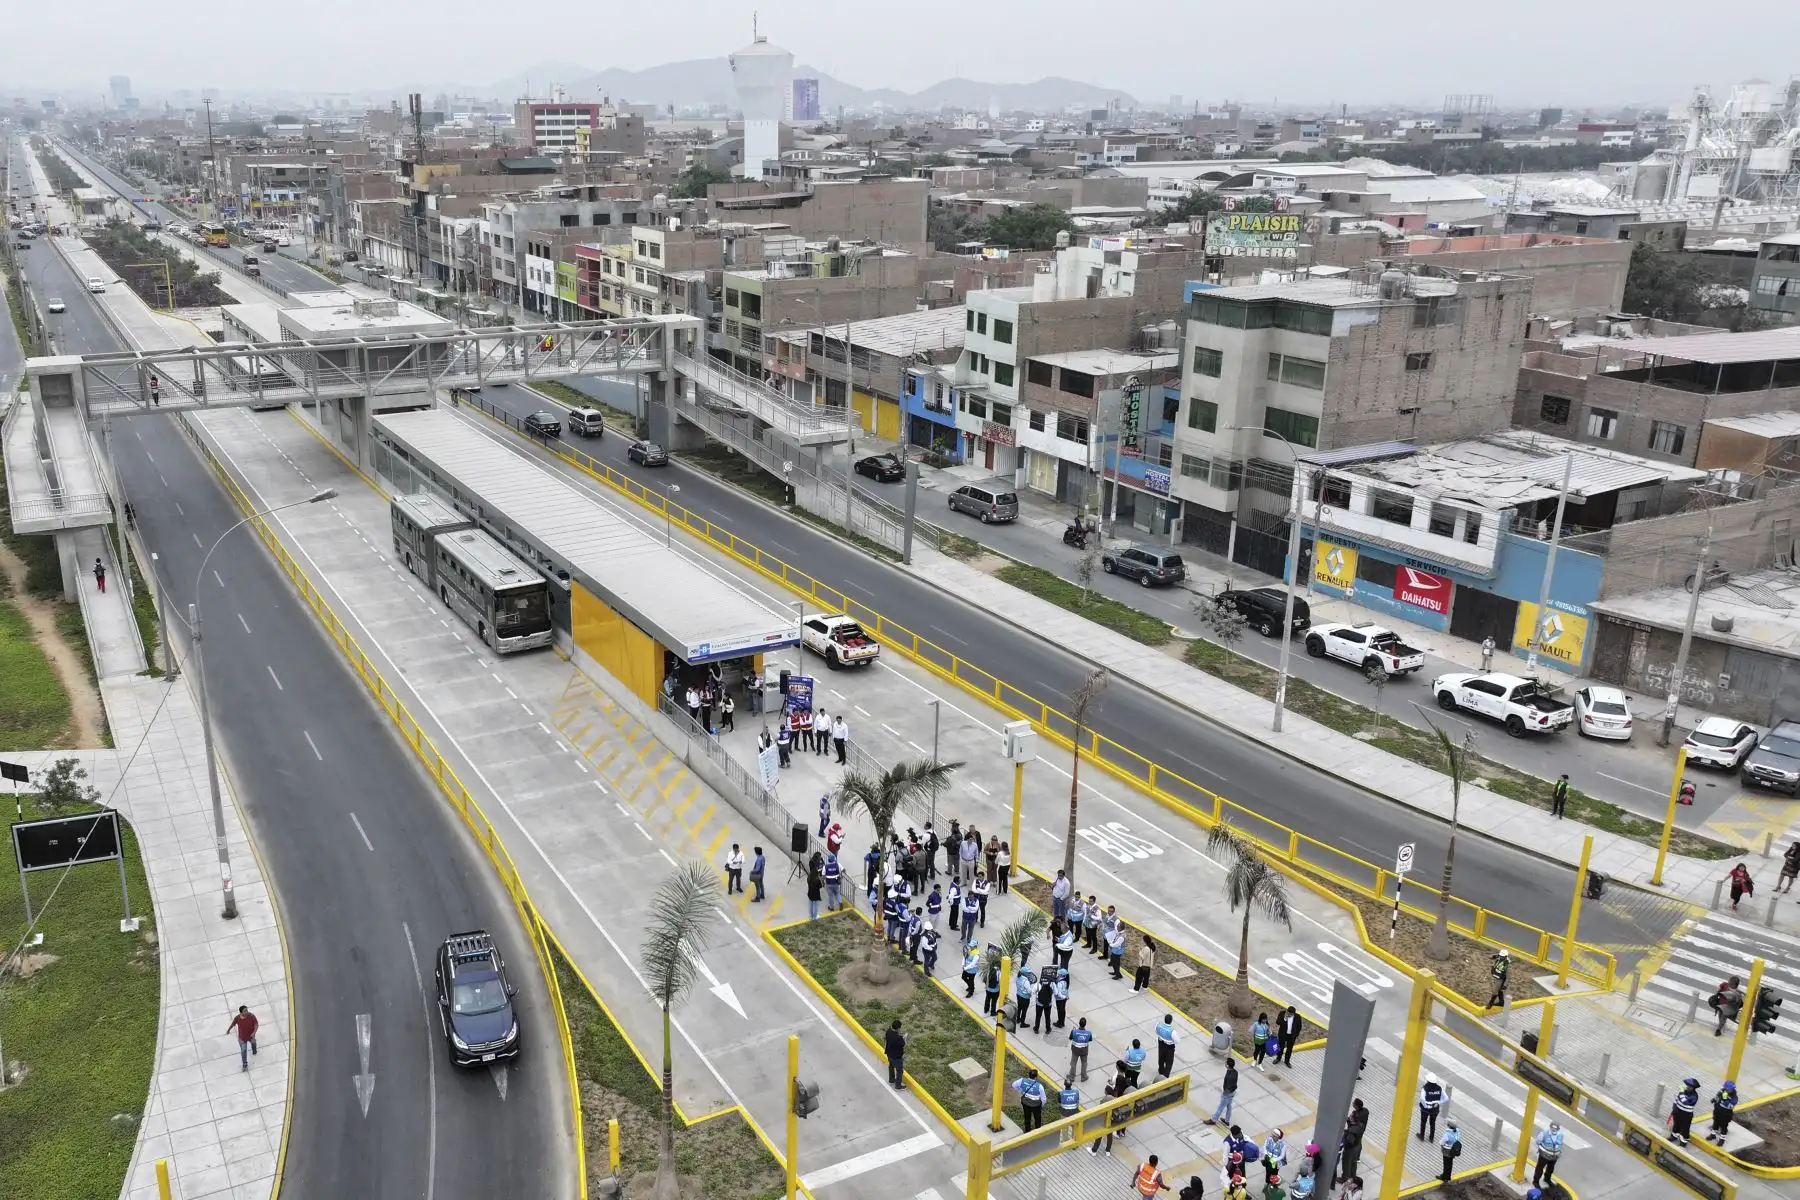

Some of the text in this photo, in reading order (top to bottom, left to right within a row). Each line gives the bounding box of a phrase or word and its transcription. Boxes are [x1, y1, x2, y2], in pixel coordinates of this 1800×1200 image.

[1224, 197, 1235, 210] 15
[1277, 198, 1288, 211] 20
[1190, 219, 1202, 234] 10
[1229, 215, 1300, 232] PLAISIR
[1306, 219, 1321, 234] 25
[1205, 245, 1297, 258] COCHERA
[1128, 392, 1140, 445] HOSTAL
[1145, 470, 1170, 482] HOSTAL
[1406, 557, 1448, 575] SERVICIO
[1317, 572, 1352, 588] RENAULT
[1401, 591, 1442, 611] DAIHATSU
[1526, 638, 1573, 661] RNAULT
[1462, 696, 1479, 707] LIMA
[1076, 821, 1165, 864] BUS
[1264, 942, 1395, 1005] SOLO
